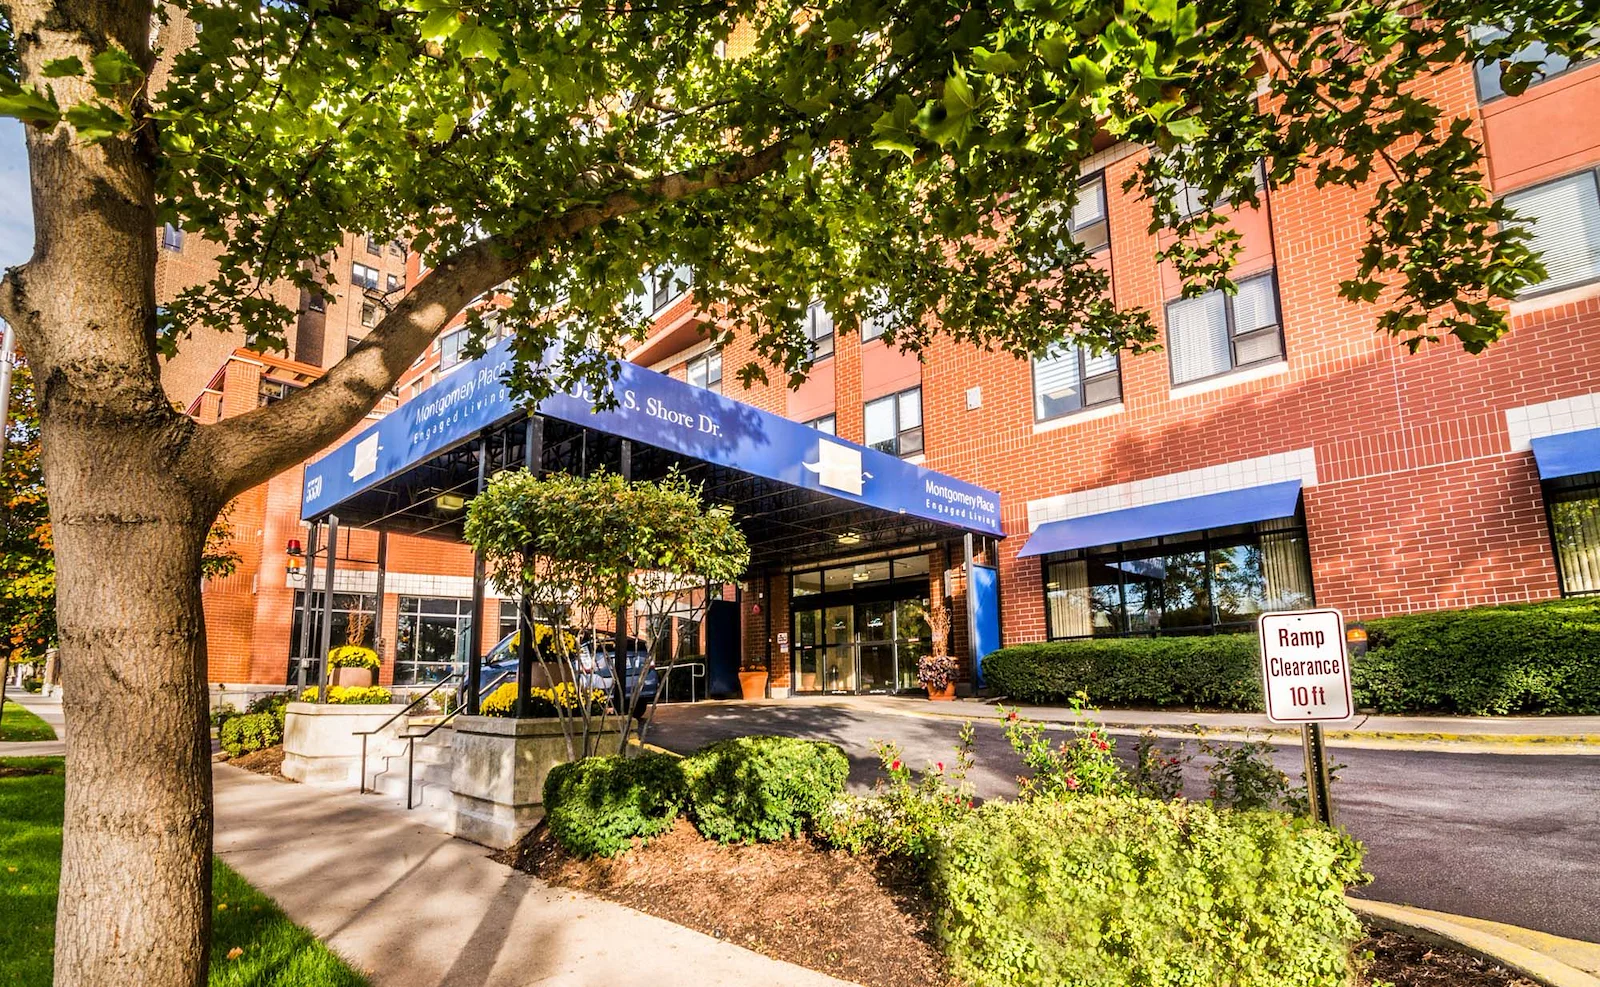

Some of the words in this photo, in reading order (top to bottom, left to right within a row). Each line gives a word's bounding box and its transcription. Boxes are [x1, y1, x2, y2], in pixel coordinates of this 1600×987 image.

[415, 378, 477, 426] Montgomery
[477, 361, 507, 390] Place
[413, 410, 459, 445] Engaged
[464, 388, 505, 417] Living
[624, 390, 640, 411] S.
[646, 397, 694, 428] Shore
[698, 414, 723, 438] Dr.
[925, 479, 977, 509] Montgomery
[976, 495, 995, 513] Place
[925, 498, 966, 518] Engaged
[969, 511, 996, 528] Living
[1278, 628, 1325, 649] Ramp
[1270, 657, 1340, 677] Clearance
[1290, 686, 1309, 706] 10
[1311, 686, 1326, 706] ft
